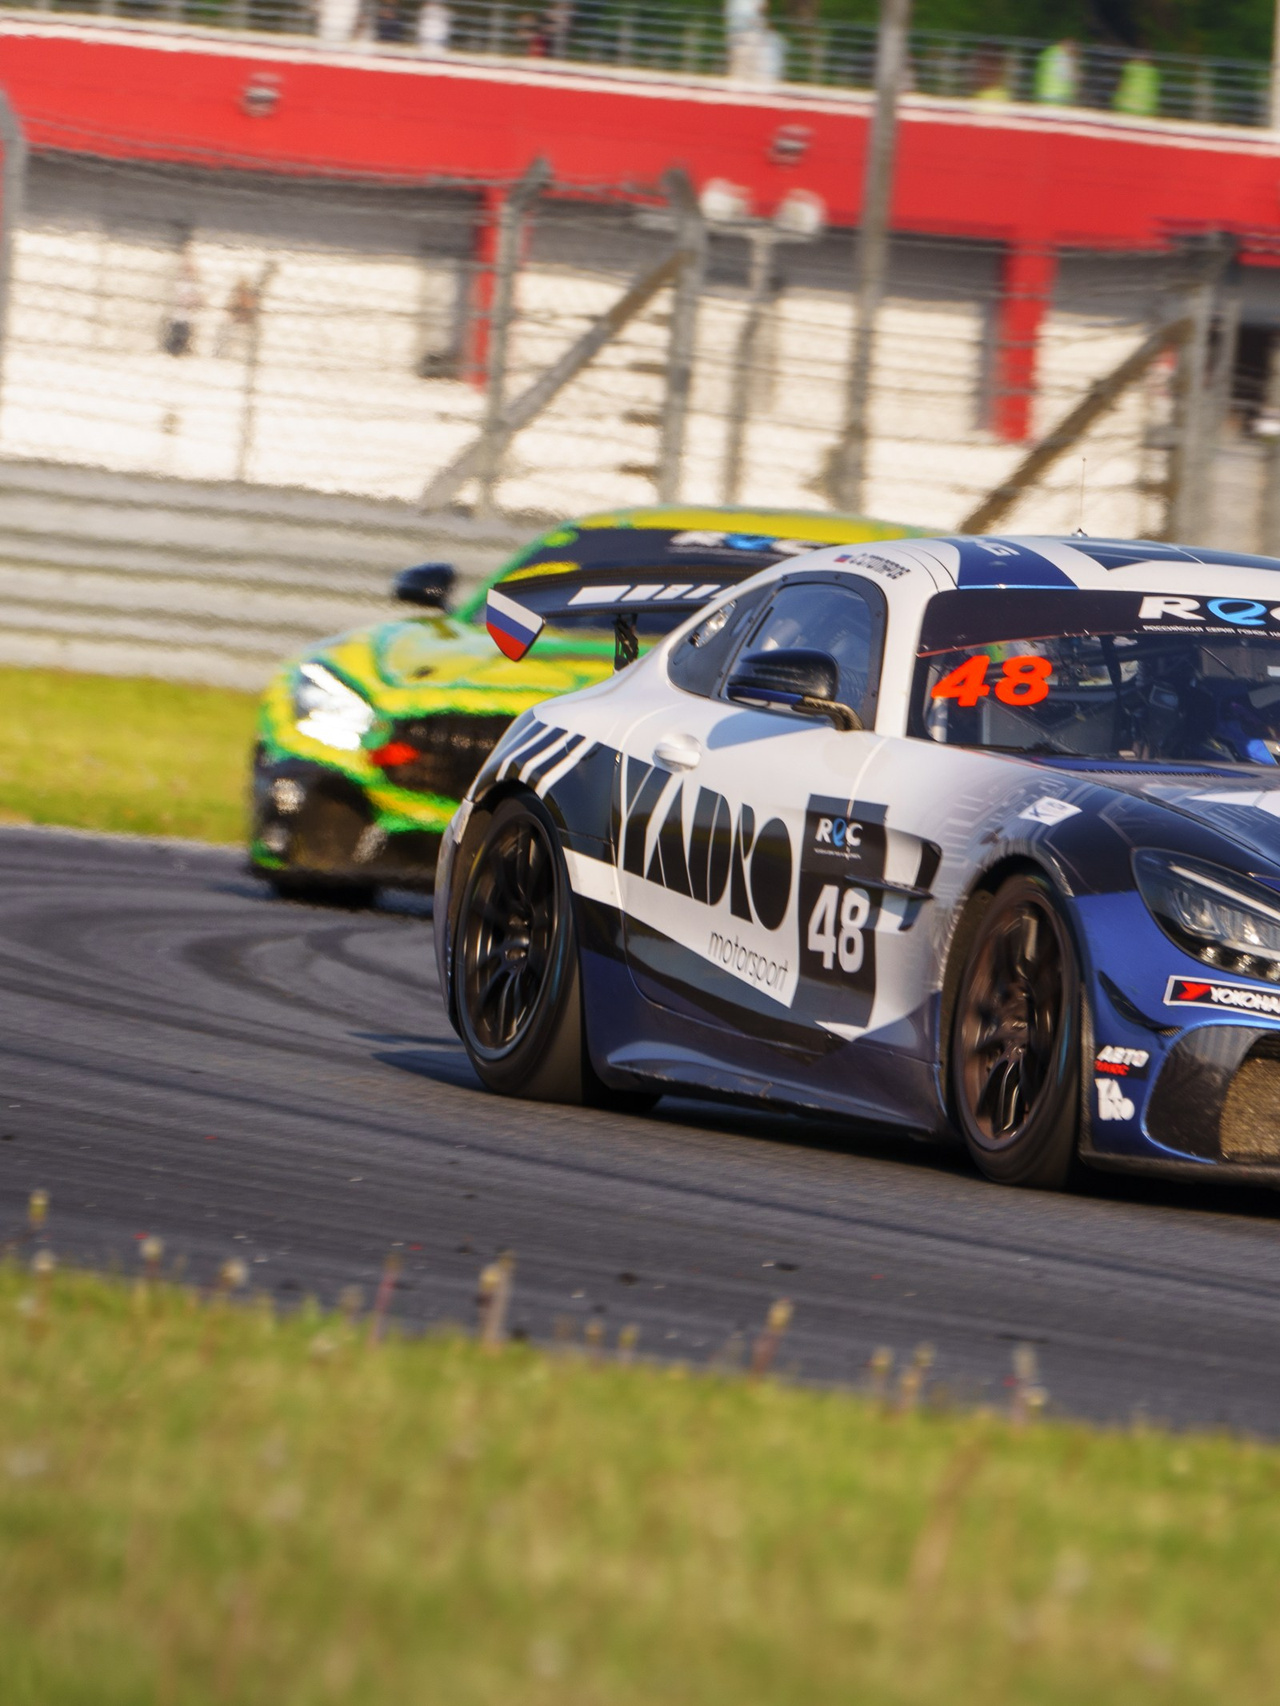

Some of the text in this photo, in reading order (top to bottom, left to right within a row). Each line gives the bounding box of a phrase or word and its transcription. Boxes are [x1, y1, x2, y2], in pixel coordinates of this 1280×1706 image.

[930, 654, 1053, 707] 48
[623, 755, 793, 932] YADRO
[708, 931, 790, 993] motorsport
[807, 884, 871, 973] 48
